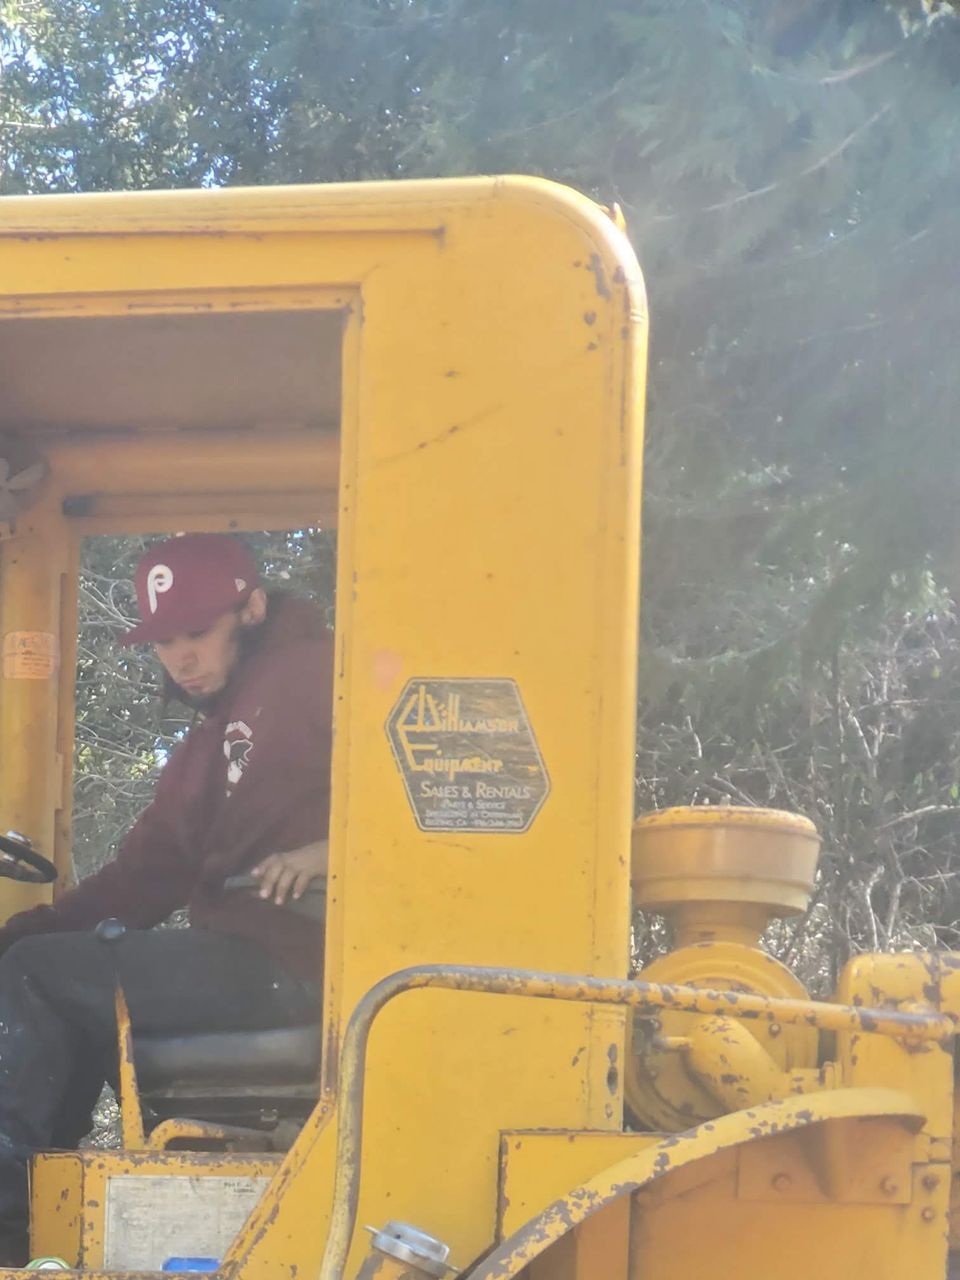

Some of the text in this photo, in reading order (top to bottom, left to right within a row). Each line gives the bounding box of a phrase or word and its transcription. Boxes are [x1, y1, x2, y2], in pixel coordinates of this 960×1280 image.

[147, 564, 174, 614] P
[420, 781, 529, 800] SALES & RENTALS
